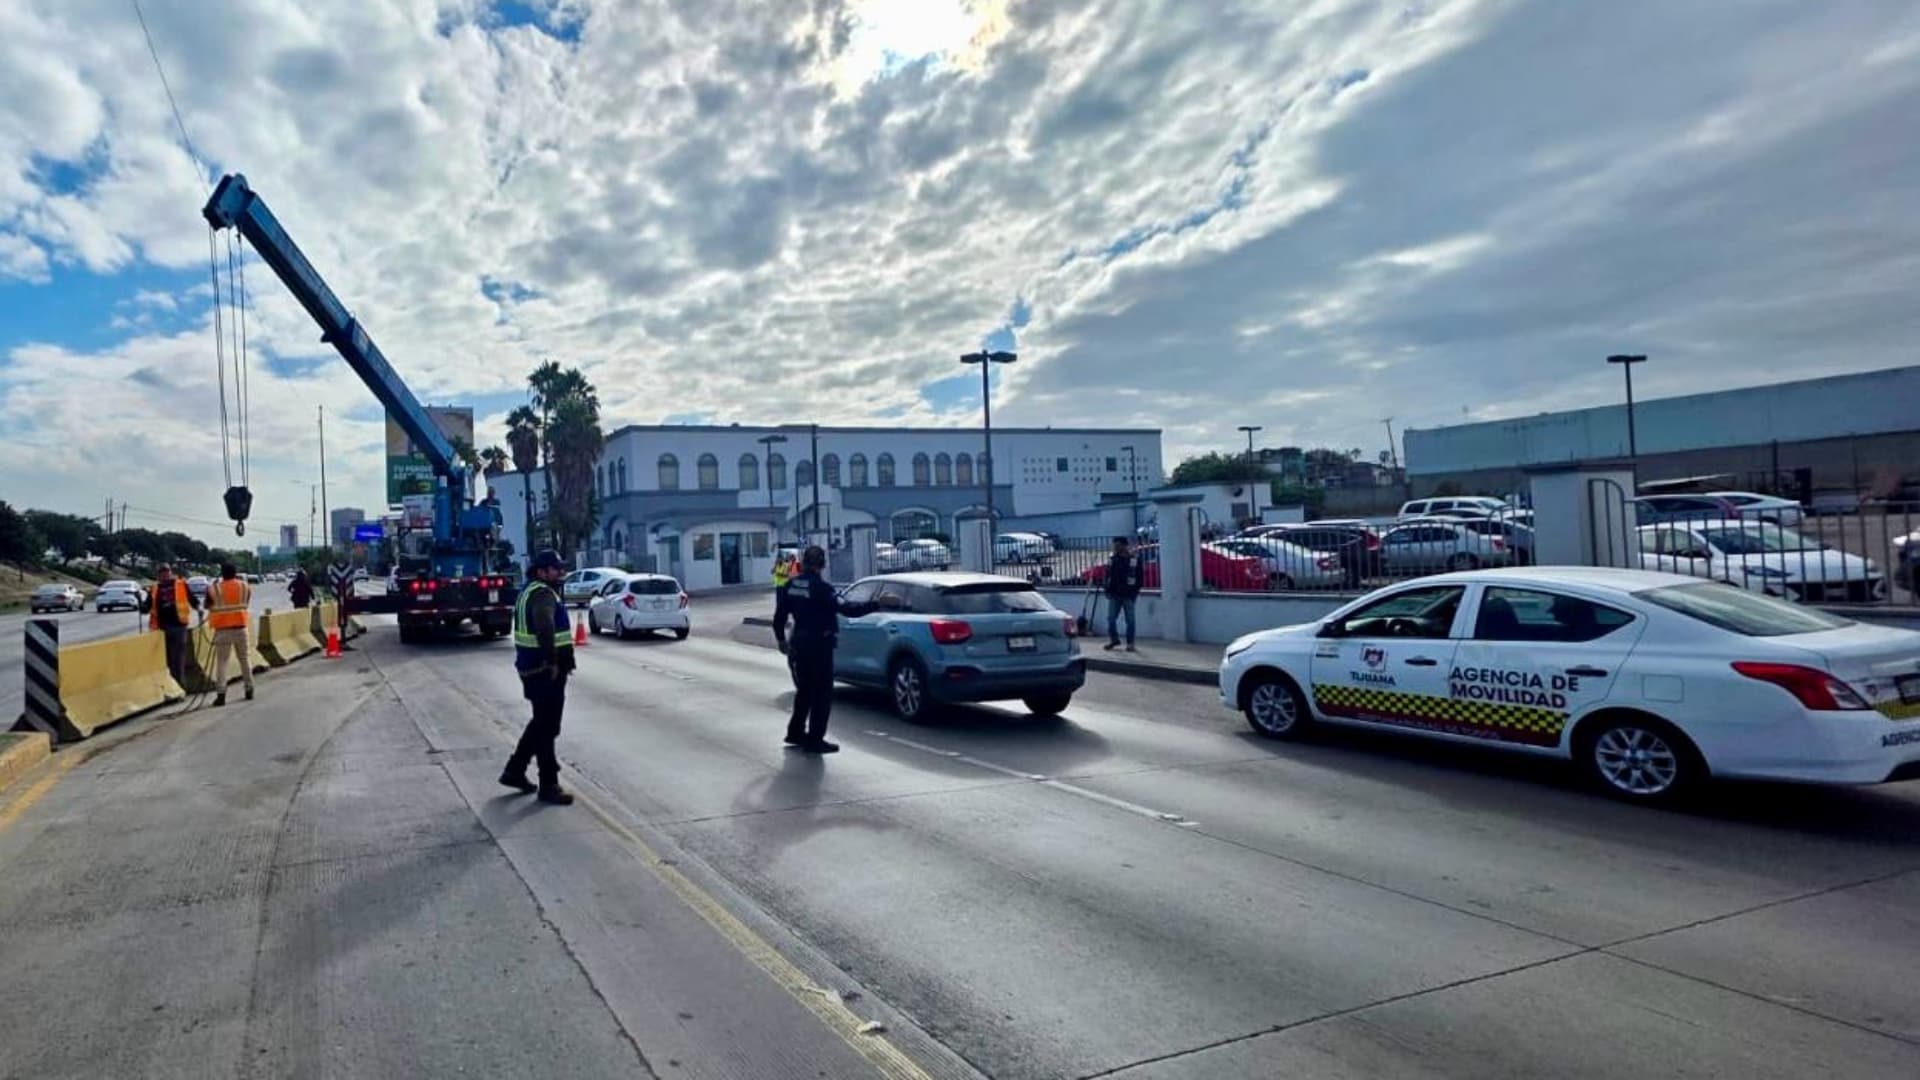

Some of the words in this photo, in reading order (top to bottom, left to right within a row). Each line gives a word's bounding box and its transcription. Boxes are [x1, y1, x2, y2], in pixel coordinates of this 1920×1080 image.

[1350, 671, 1396, 686] TIJUANA
[1451, 667, 1547, 688] AGENCIA
[1551, 674, 1580, 692] DE
[1451, 682, 1567, 709] MOVILIDAD
